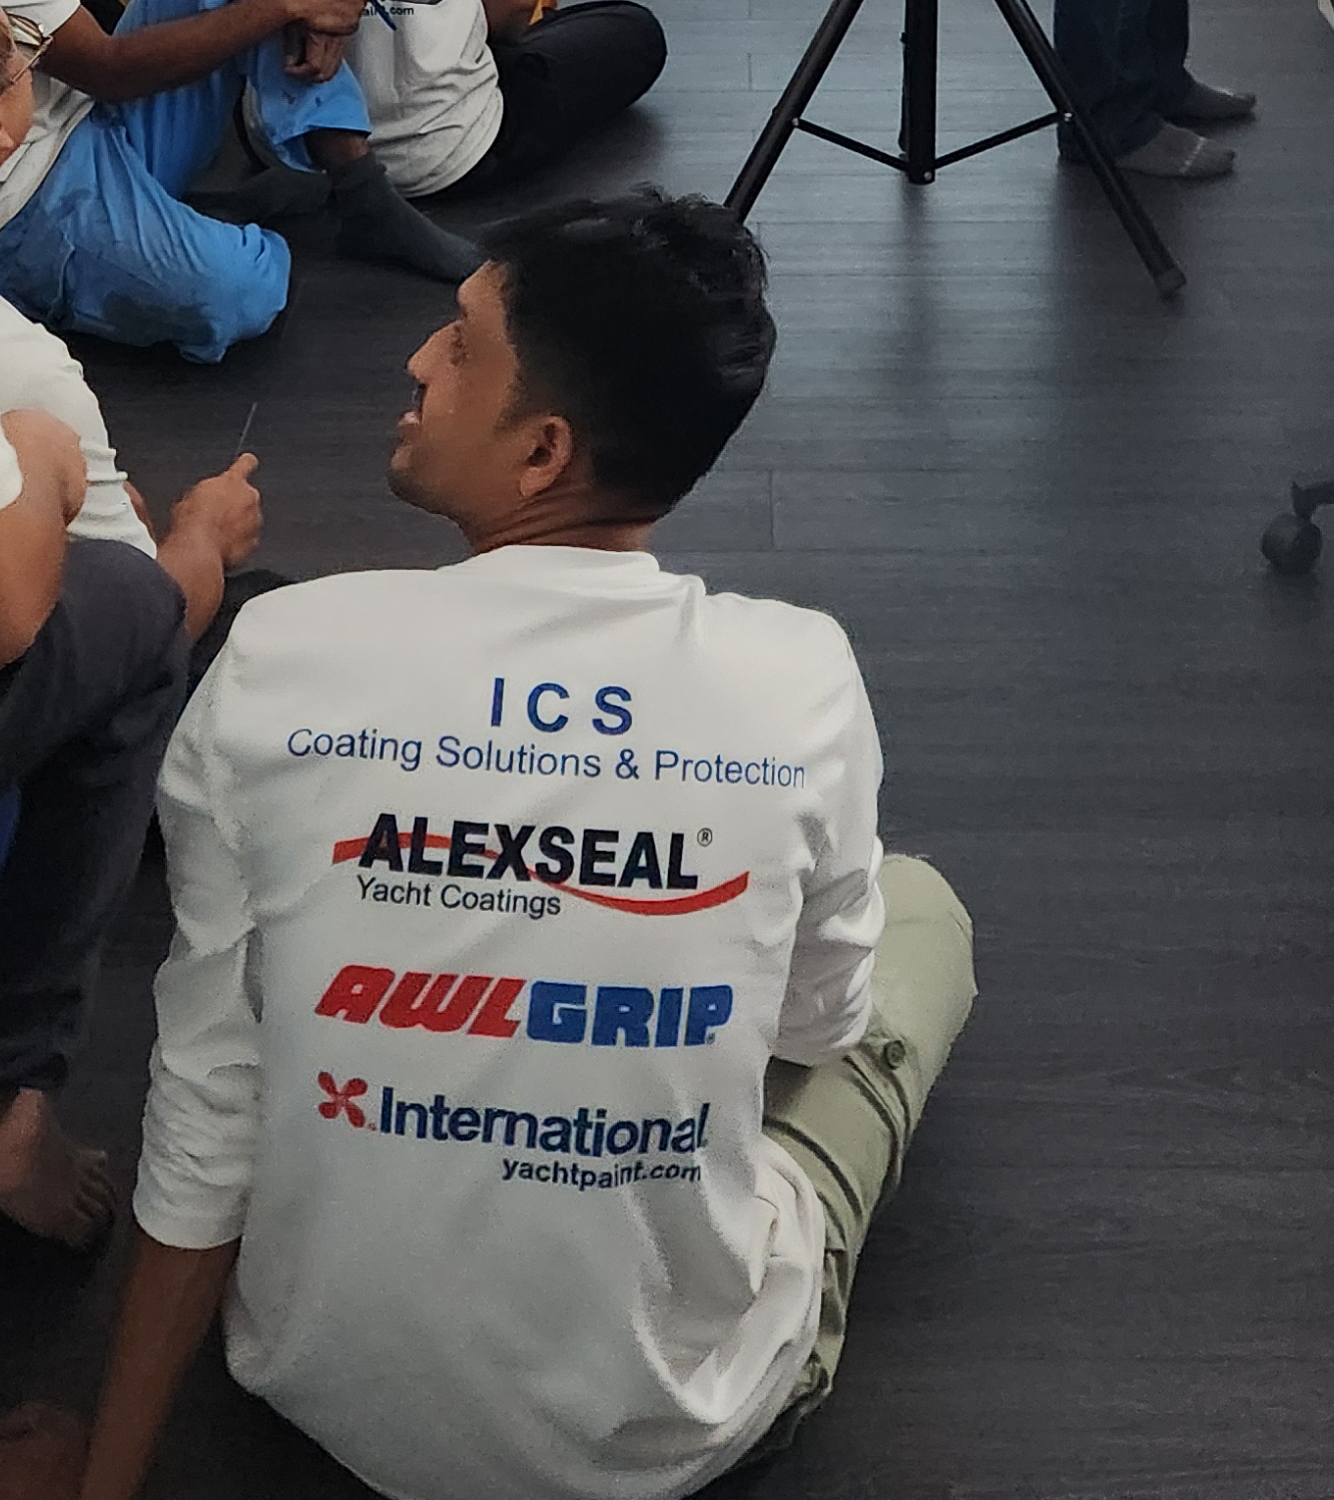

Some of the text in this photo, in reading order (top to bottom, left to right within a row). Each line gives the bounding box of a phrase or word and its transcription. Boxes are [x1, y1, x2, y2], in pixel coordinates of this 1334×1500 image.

[287, 728, 806, 789] Coating Solutions & Protection
[358, 813, 699, 890] ALEXSEAL
[355, 874, 561, 919] Yacht Coatings
[315, 964, 734, 1048] AWLGRIP
[380, 1086, 711, 1157] International
[501, 1158, 702, 1191] yachtpaint.com
